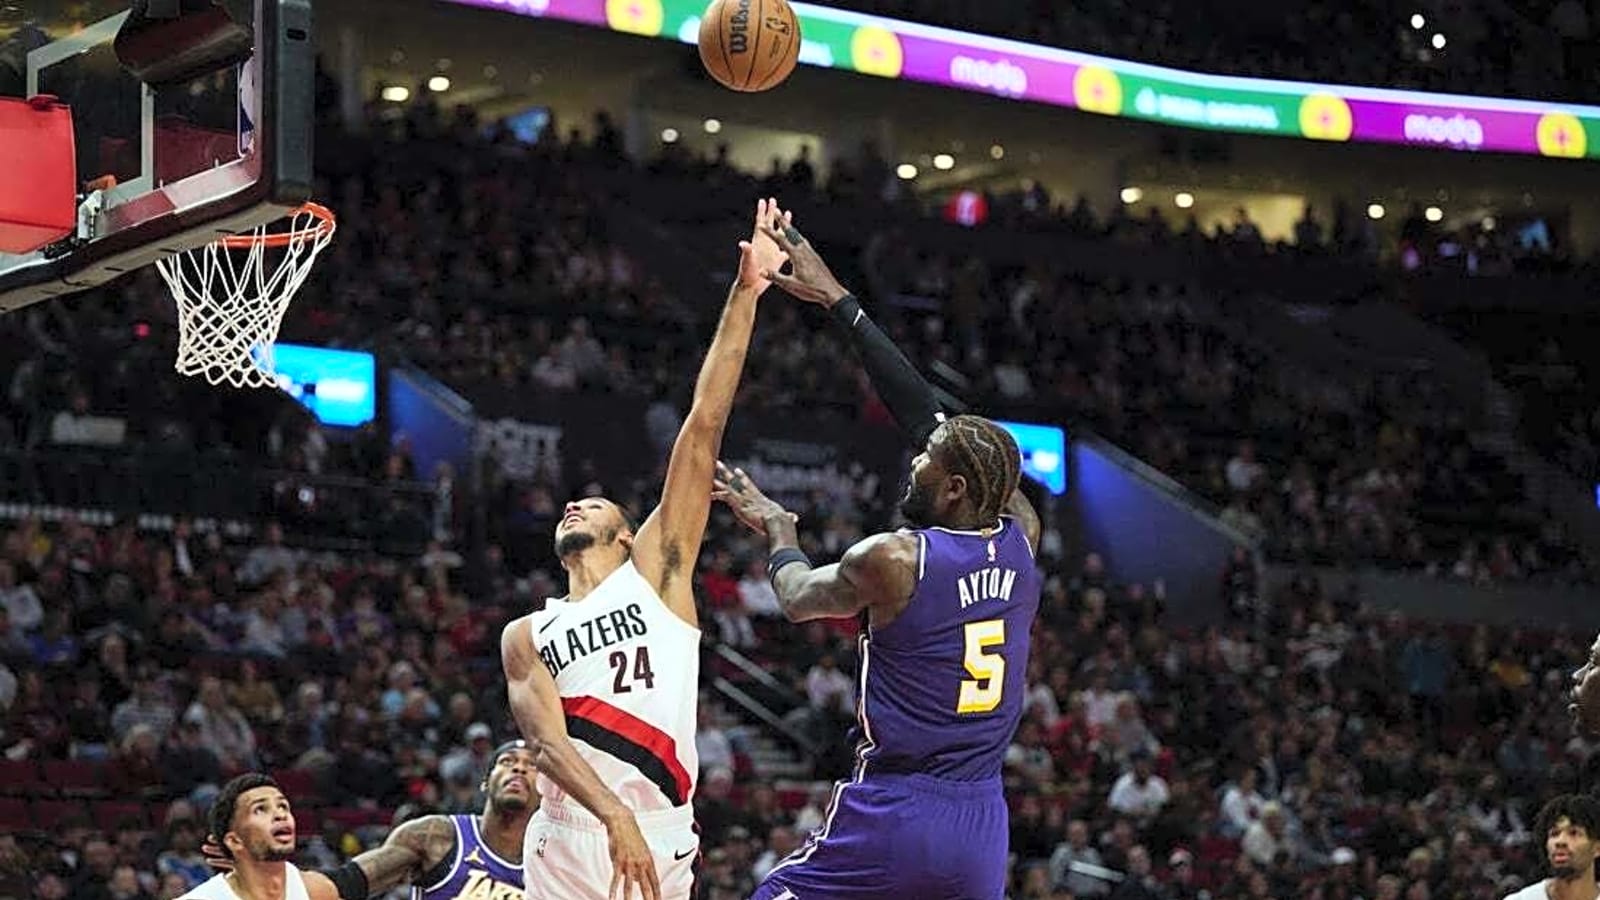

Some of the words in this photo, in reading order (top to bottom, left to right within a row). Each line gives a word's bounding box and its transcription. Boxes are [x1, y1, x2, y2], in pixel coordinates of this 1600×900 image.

[1403, 112, 1484, 145] moda
[957, 567, 1016, 609] AYTON
[540, 603, 648, 680] BLAZERS
[957, 619, 1005, 713] 5
[608, 646, 655, 695] 24
